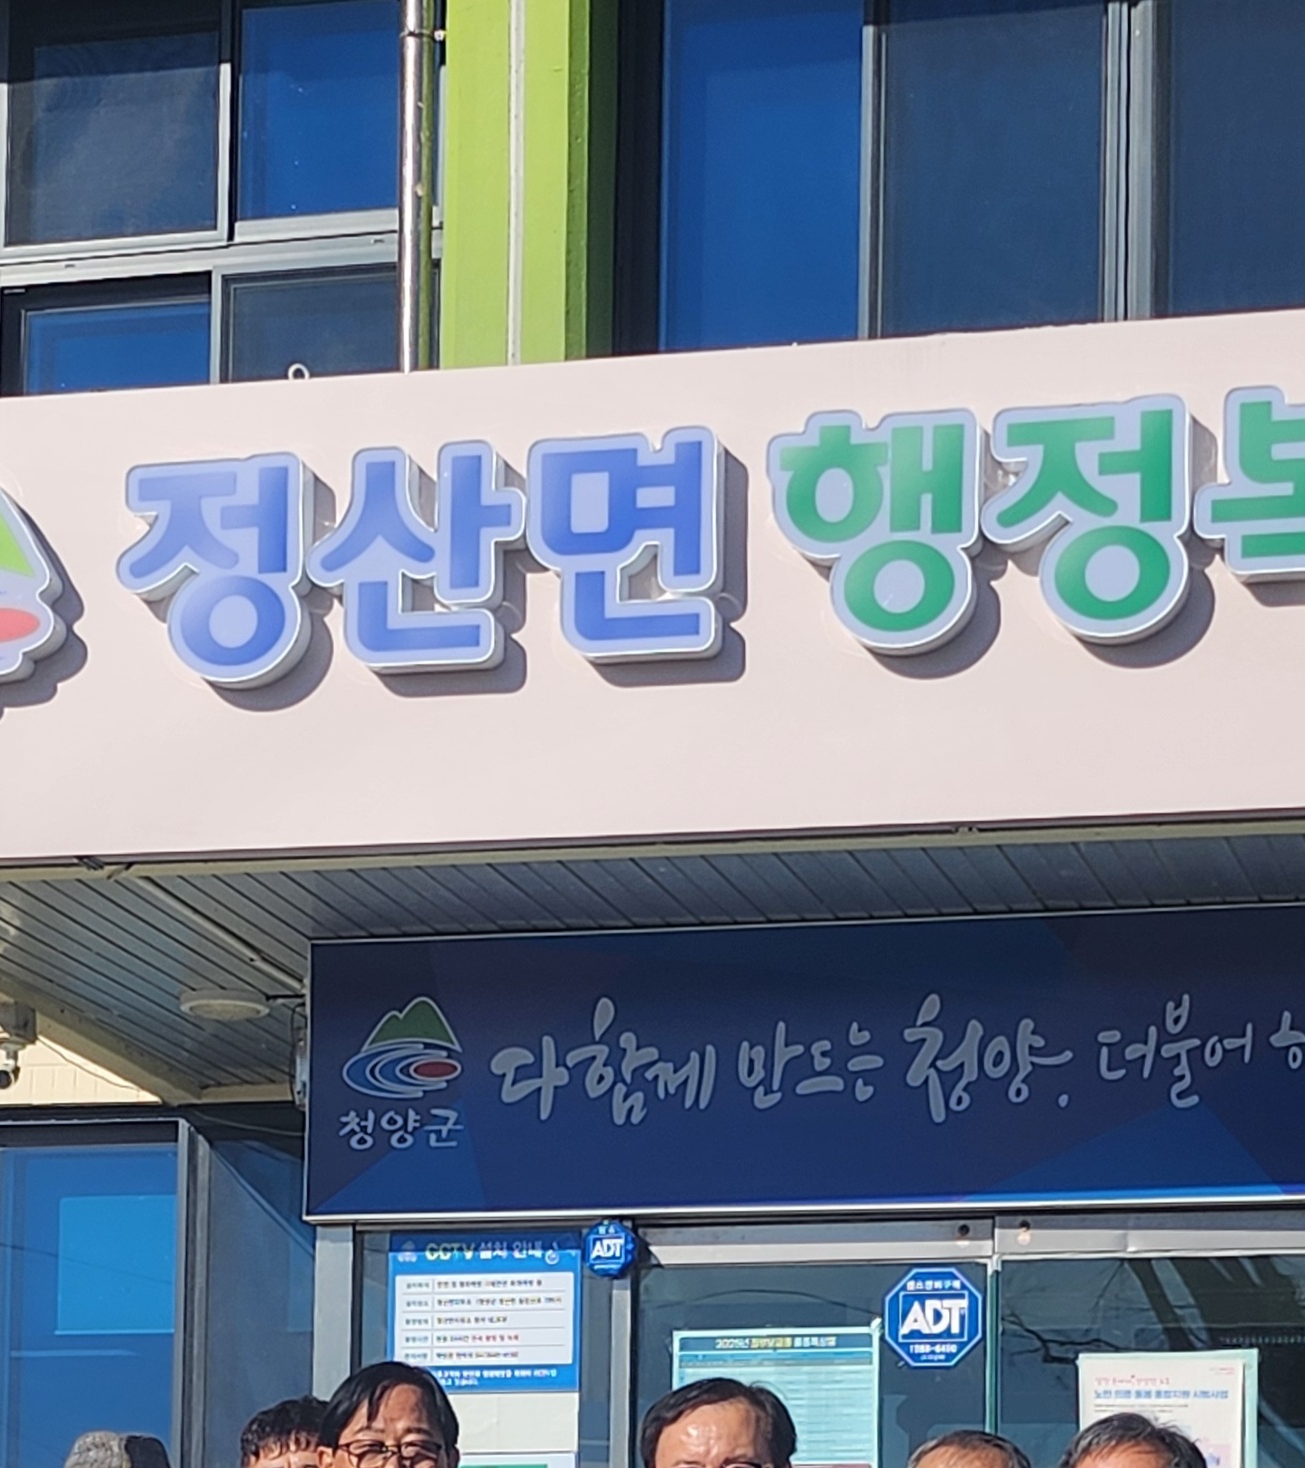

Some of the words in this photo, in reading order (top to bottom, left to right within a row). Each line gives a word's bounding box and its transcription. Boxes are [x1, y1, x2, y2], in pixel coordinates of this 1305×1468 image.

[115, 428, 737, 692] 정산면
[491, 998, 717, 1125] 다함께
[737, 1020, 885, 1108] 만드는
[1095, 994, 1253, 1109] 더불어
[339, 1109, 465, 1150] 청양군
[425, 1243, 474, 1261] CCTV
[590, 1238, 624, 1259] ADT
[900, 1298, 969, 1336] ADT
